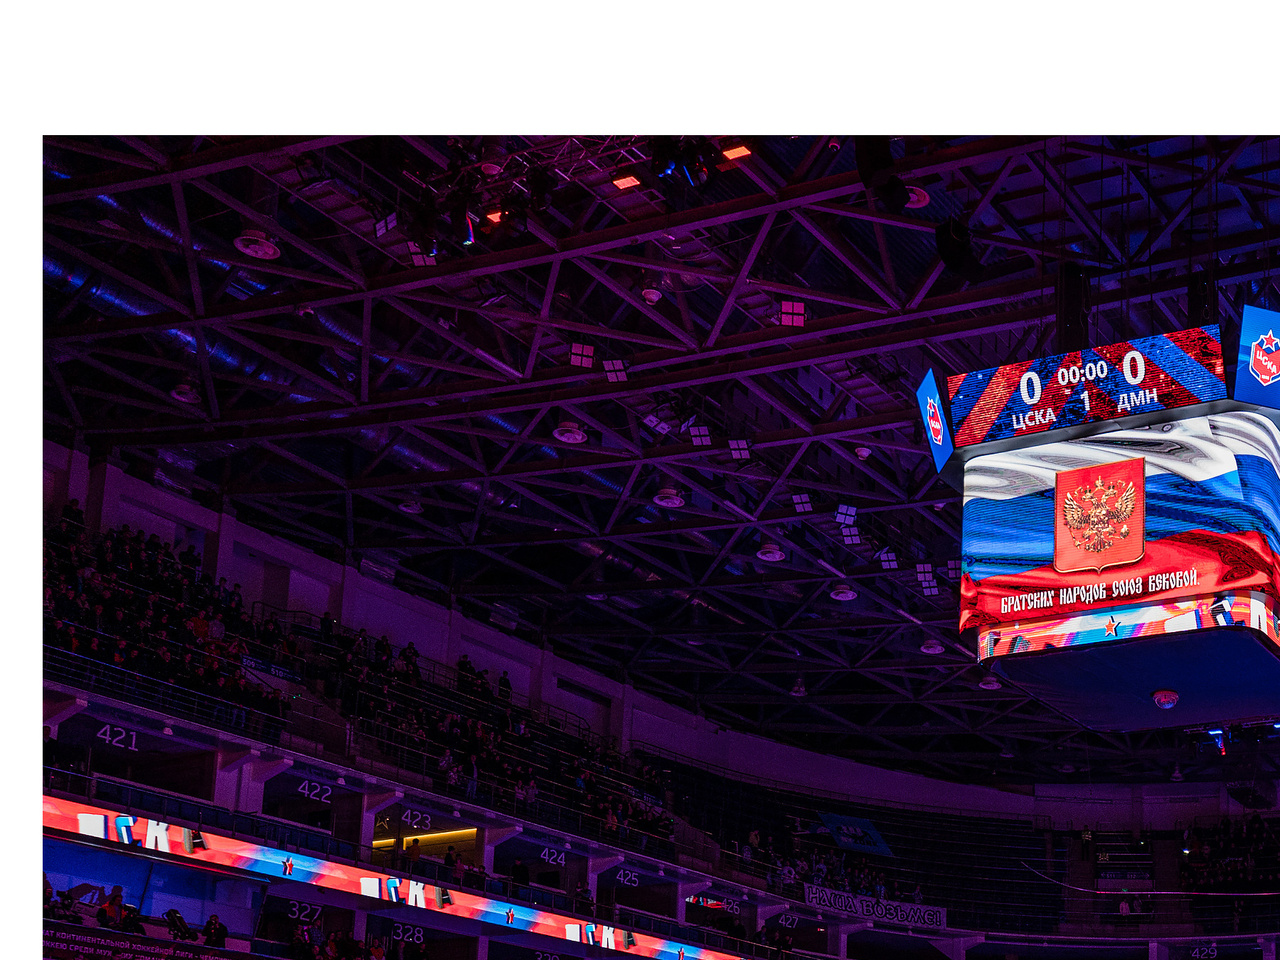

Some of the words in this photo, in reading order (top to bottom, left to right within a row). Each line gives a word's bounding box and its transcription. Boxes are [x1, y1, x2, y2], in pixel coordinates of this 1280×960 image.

[1123, 350, 1145, 385] 0
[1256, 350, 1276, 373] ЦСКА
[1058, 361, 1108, 386] 00:00
[1020, 371, 1042, 405] 0
[1080, 390, 1090, 411] 1
[1117, 388, 1158, 412] ДМН
[1012, 408, 1057, 430] ЦСКА
[1001, 590, 1054, 613] БРАТСКИХ
[1059, 582, 1107, 605] НАРОДОВ
[1112, 577, 1143, 596] СОЮЗ
[97, 724, 138, 752] 421
[298, 780, 331, 804] 422
[401, 809, 431, 831] 423
[540, 848, 566, 867] 424
[616, 869, 639, 888] 425
[287, 900, 322, 922] 327
[808, 887, 857, 914] НАША
[779, 914, 799, 929] 427
[393, 923, 424, 944] 328
[96, 948, 133, 960] МУЖИХ
[1191, 947, 1218, 959] 429
